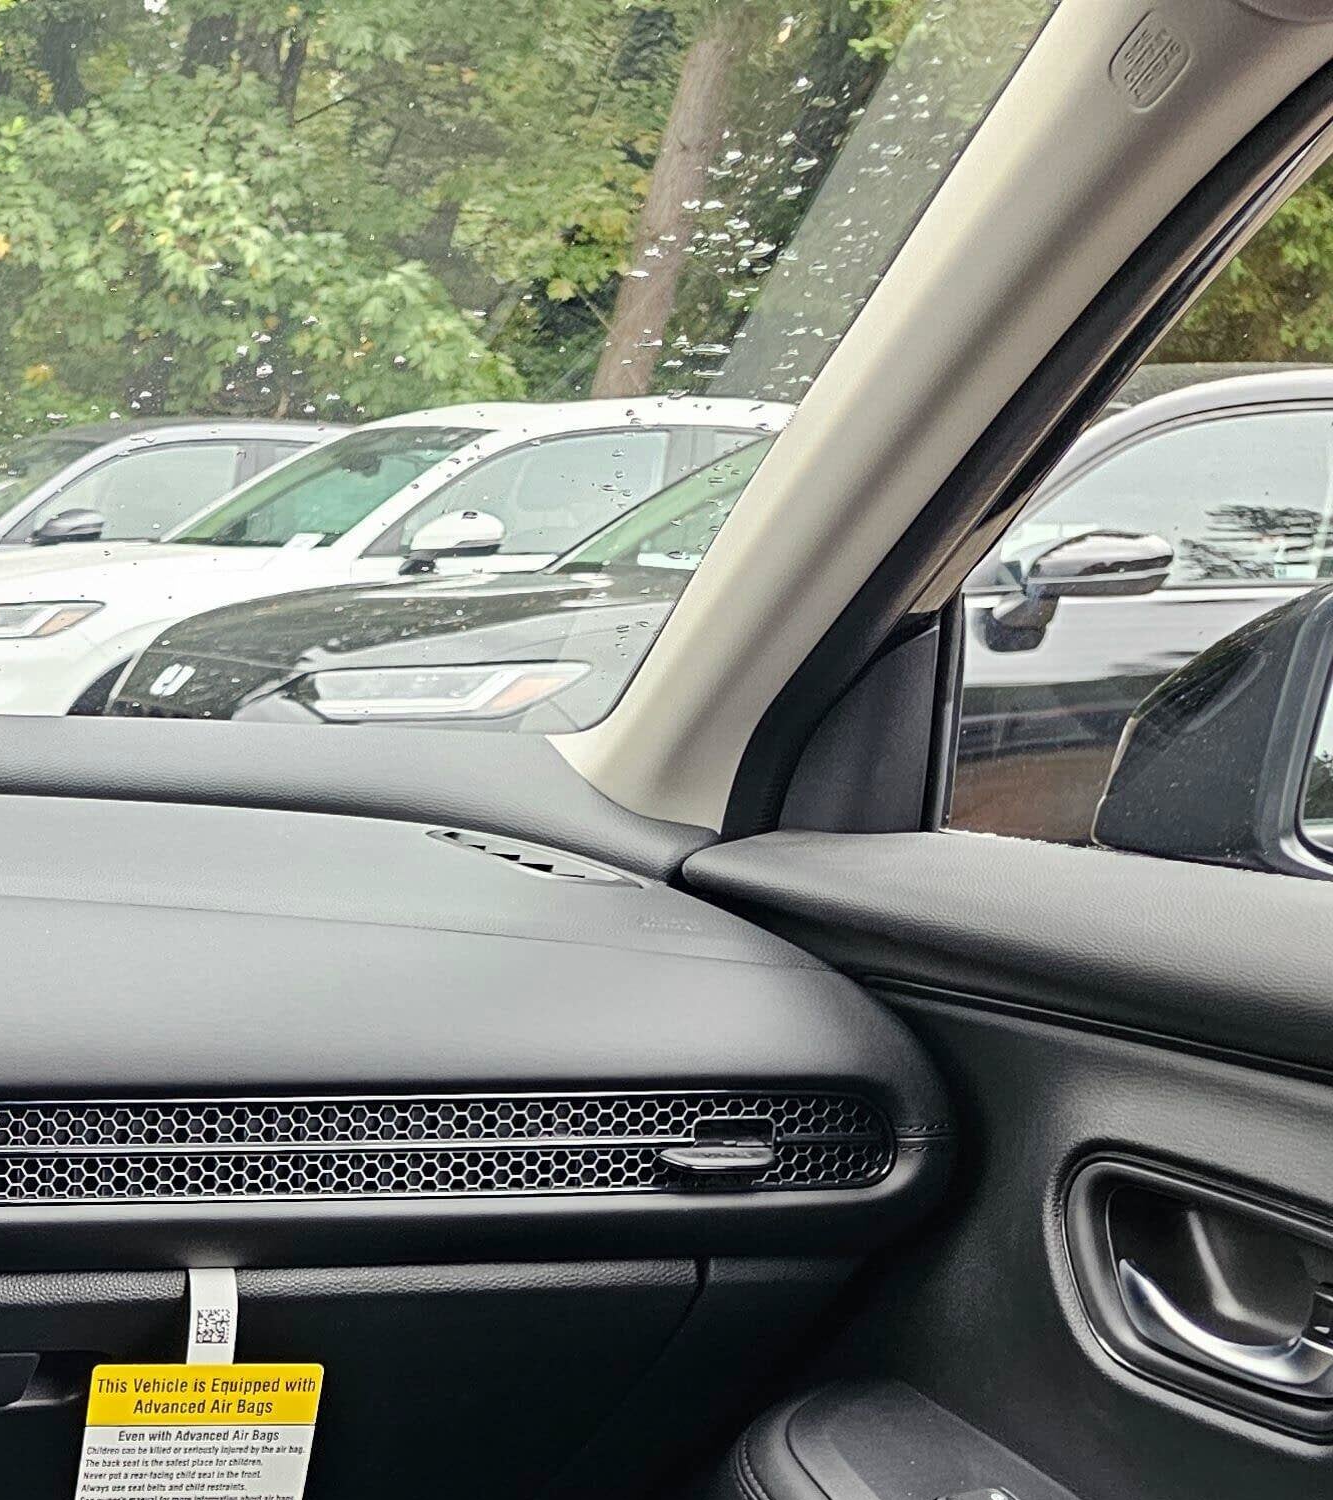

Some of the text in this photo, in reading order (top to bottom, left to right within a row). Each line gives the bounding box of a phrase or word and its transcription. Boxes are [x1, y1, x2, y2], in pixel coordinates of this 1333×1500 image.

[97, 1377, 316, 1396] This Vehicle is Equipped with
[132, 1399, 273, 1417] Advanced Air Bags
[118, 1429, 280, 1443] Even with Advanced Air Bags
[86, 1446, 120, 1455] Children
[121, 1447, 136, 1455] can
[137, 1446, 148, 1455] be
[149, 1446, 172, 1455] killed
[173, 1447, 182, 1455] or
[221, 1446, 249, 1455] injured
[250, 1446, 260, 1455] by
[261, 1445, 274, 1454] the
[275, 1445, 287, 1454] air
[85, 1458, 263, 1468] The back seat is the safest place for children.
[83, 1472, 107, 1480] Never
[108, 1472, 122, 1481] put
[175, 1471, 196, 1480] child
[197, 1470, 215, 1479] seat
[216, 1470, 225, 1479] in
[226, 1470, 239, 1479] the
[81, 1483, 247, 1493] Always use seat belts and child restraints.
